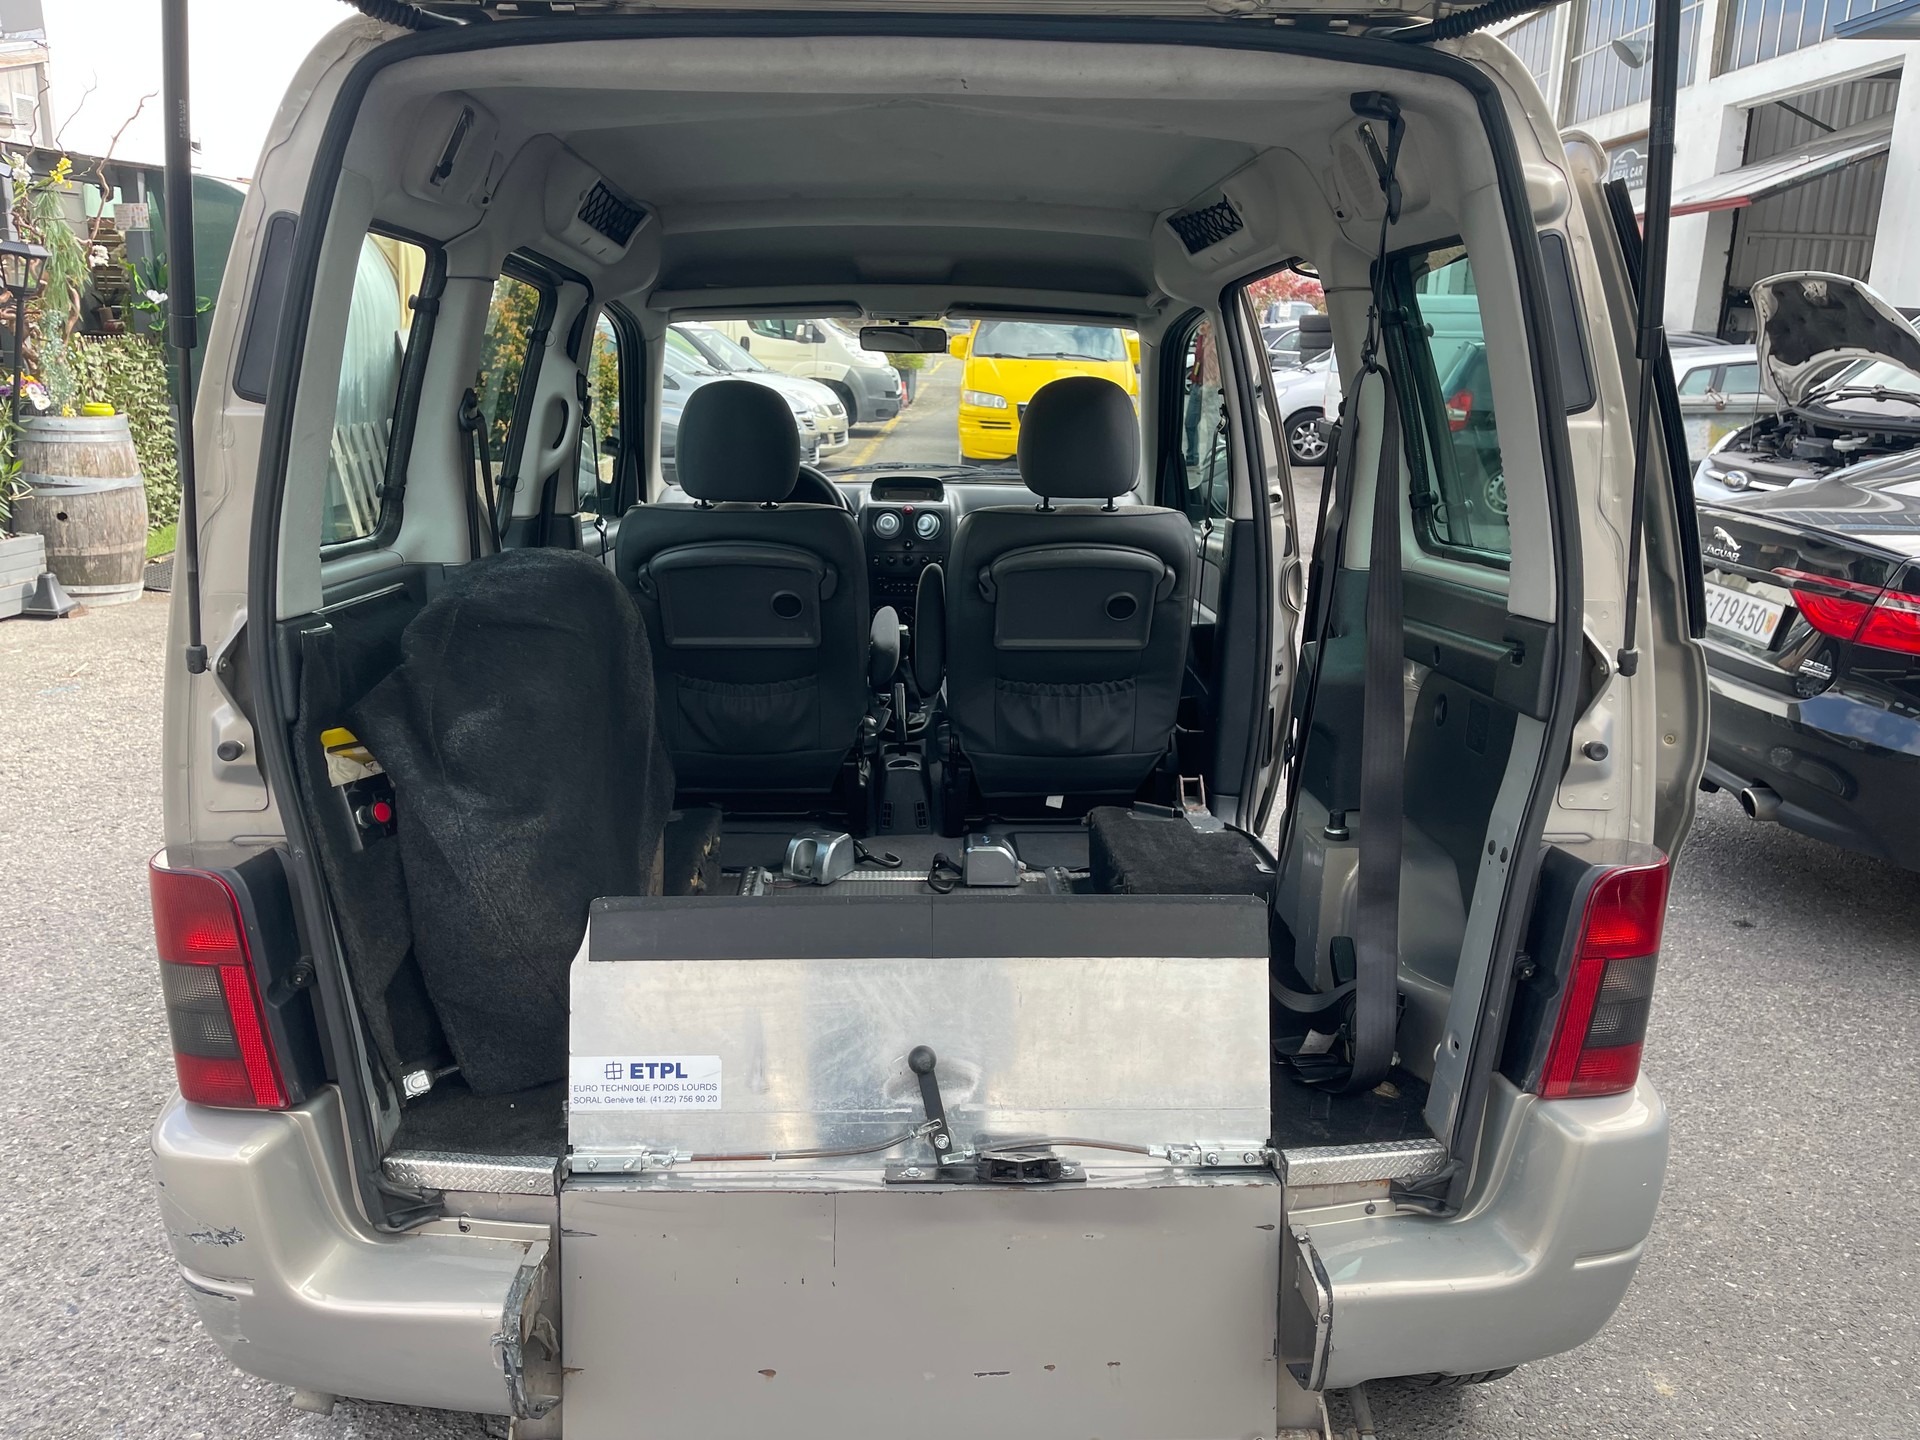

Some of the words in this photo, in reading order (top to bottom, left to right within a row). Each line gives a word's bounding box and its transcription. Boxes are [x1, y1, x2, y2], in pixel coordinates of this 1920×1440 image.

[1704, 544, 1740, 562] JAGUAR
[630, 1062, 688, 1079] ETPL
[573, 1084, 598, 1092] EURO
[600, 1084, 650, 1092] TECHNIQUE
[653, 1083, 679, 1091] POIDS
[682, 1083, 718, 1091] LOURDS
[573, 1096, 602, 1104] SORAL
[604, 1096, 634, 1104] Genève
[679, 1095, 693, 1103] 756
[695, 1095, 706, 1103] 90
[707, 1095, 718, 1103] 20
